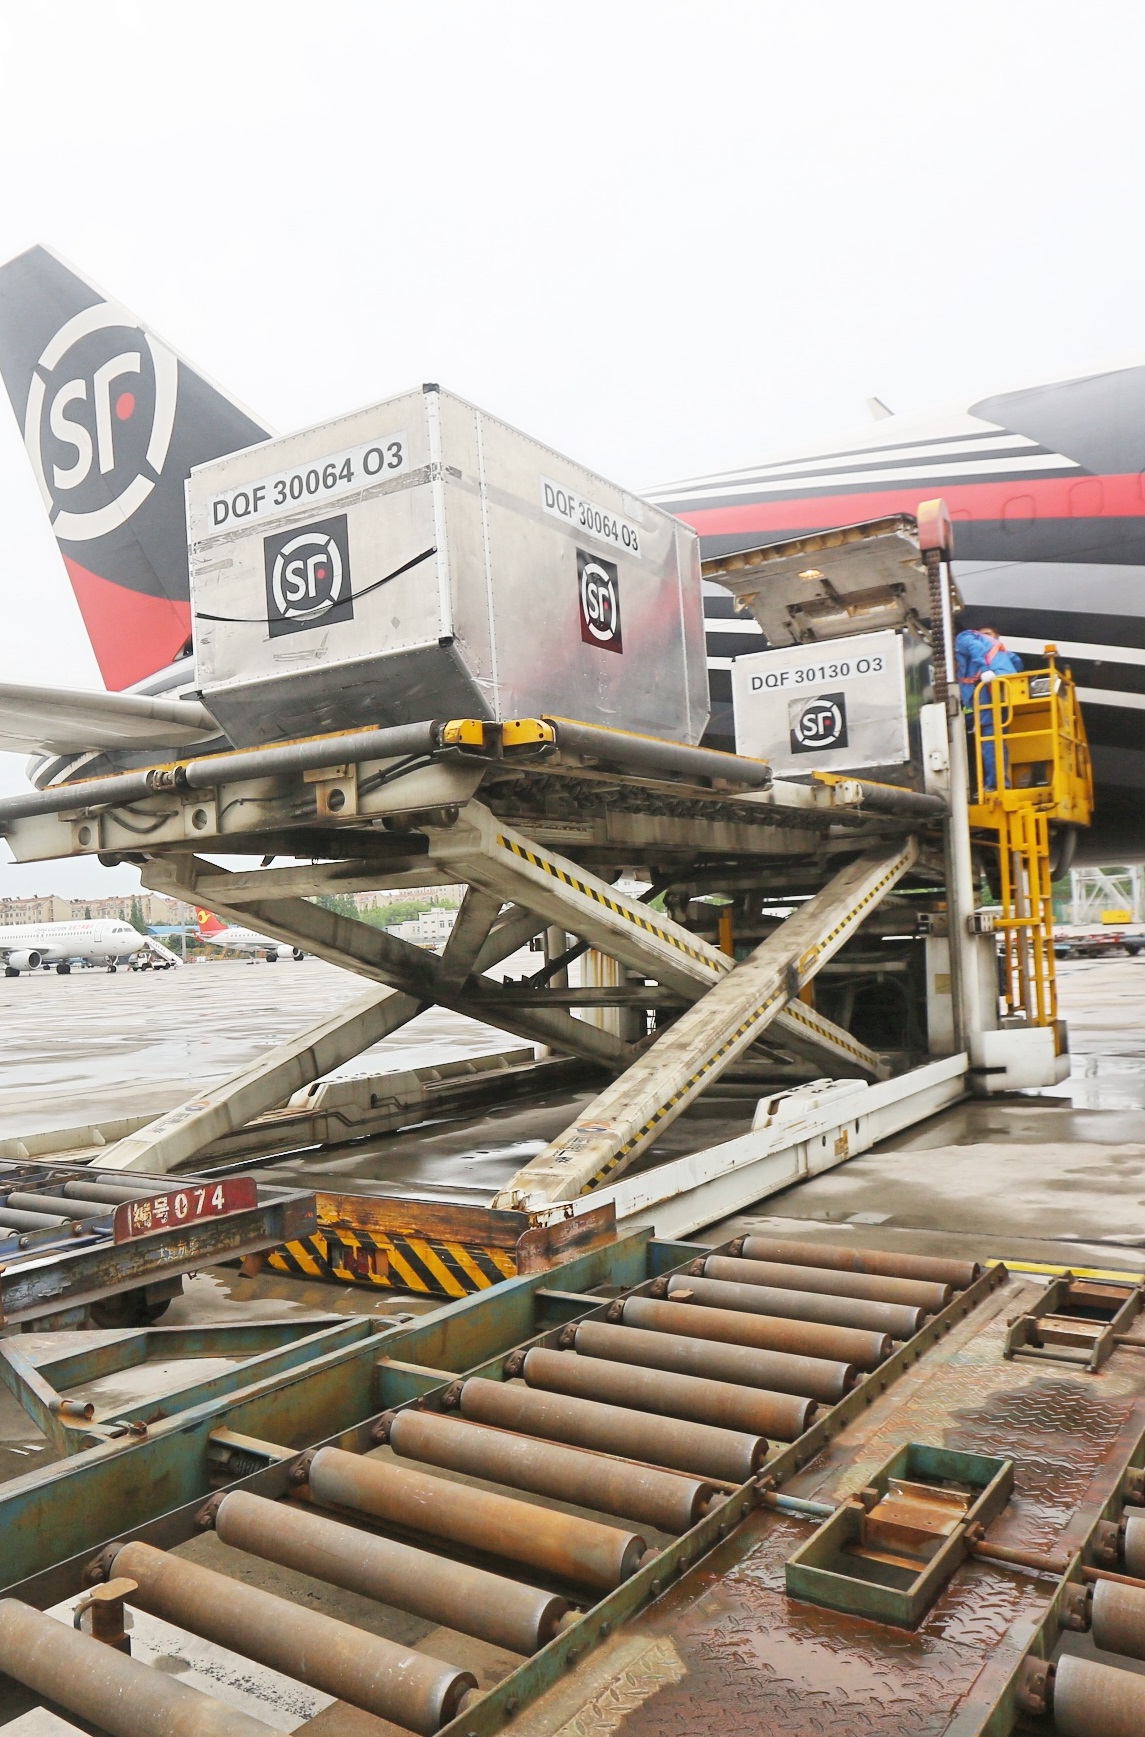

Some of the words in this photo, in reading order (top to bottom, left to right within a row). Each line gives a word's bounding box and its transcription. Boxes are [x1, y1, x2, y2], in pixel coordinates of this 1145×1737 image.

[214, 486, 266, 525] DQF
[274, 458, 355, 505] 30064
[545, 484, 576, 518] DQF
[578, 502, 619, 541] 30064
[752, 672, 790, 690] DQF
[795, 663, 851, 684] 30130
